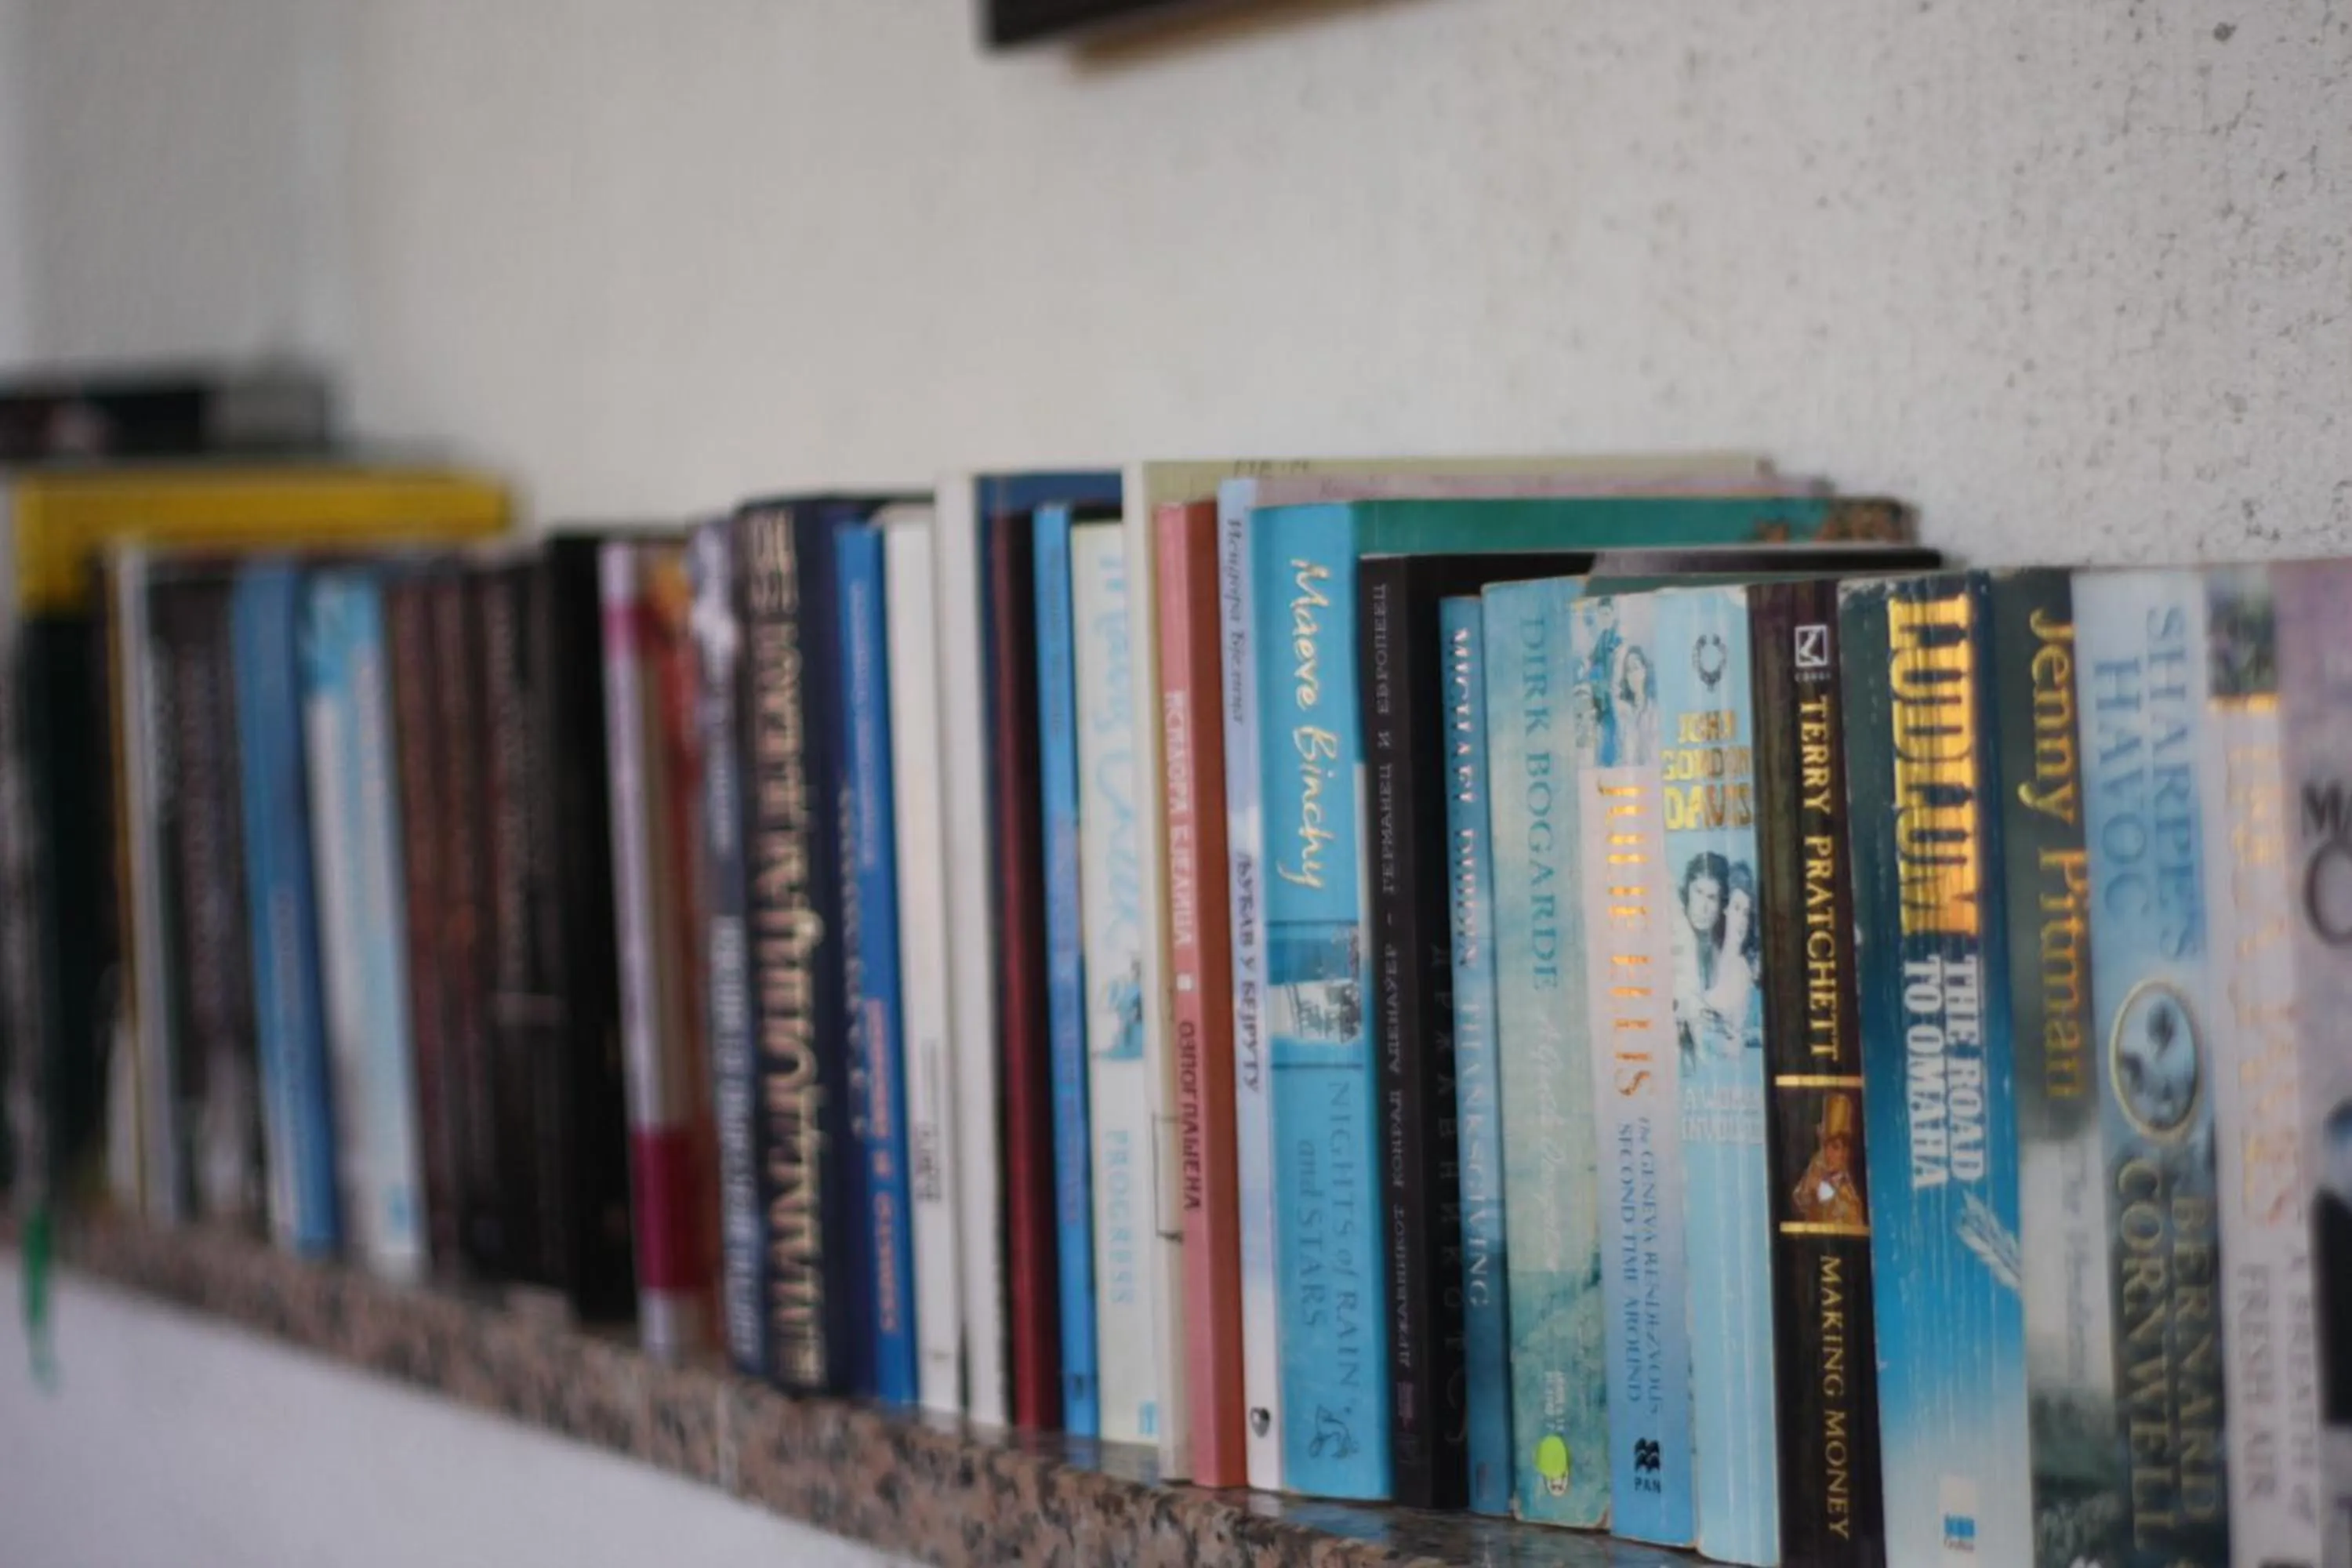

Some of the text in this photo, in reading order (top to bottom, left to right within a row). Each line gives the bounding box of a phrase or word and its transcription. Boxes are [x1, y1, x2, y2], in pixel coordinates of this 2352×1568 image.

[1278, 558, 1338, 888] Maeve Binchy
[1373, 583, 1389, 715] ЕВРОПЕЕЦ
[1377, 730, 1390, 748] И
[1678, 710, 1735, 743] JOHN
[2018, 608, 2077, 826] Jenny
[1378, 764, 1395, 895] ГЕРМАНЕЦ
[1519, 617, 1559, 993] DIRK BOGARDE
[1664, 782, 1752, 831] DAVIS
[1799, 695, 1842, 1061] TERRY PRATCHETT
[1889, 593, 1980, 936] LUDLUM
[2093, 657, 2150, 917] HAVOC
[1240, 955, 1258, 971] У
[1904, 955, 1947, 1189] TO OMAHA
[1945, 955, 1984, 1181] THE ROAD
[2038, 848, 2089, 1098] Pitman
[1297, 1139, 1327, 1328] and STARS
[1328, 1082, 1362, 1388] NIGHTS of RAIN
[1389, 1091, 1404, 1188] КОНРАД
[1639, 1151, 1658, 1243] GENEVA
[1617, 1123, 1642, 1403] SECOND TIME AROUND
[2118, 1159, 2177, 1551] CORNWELL
[2172, 1196, 2218, 1523] BERNARD
[1634, 1475, 1661, 1494] PAN
[1818, 1255, 1851, 1540] MAKING MONEY
